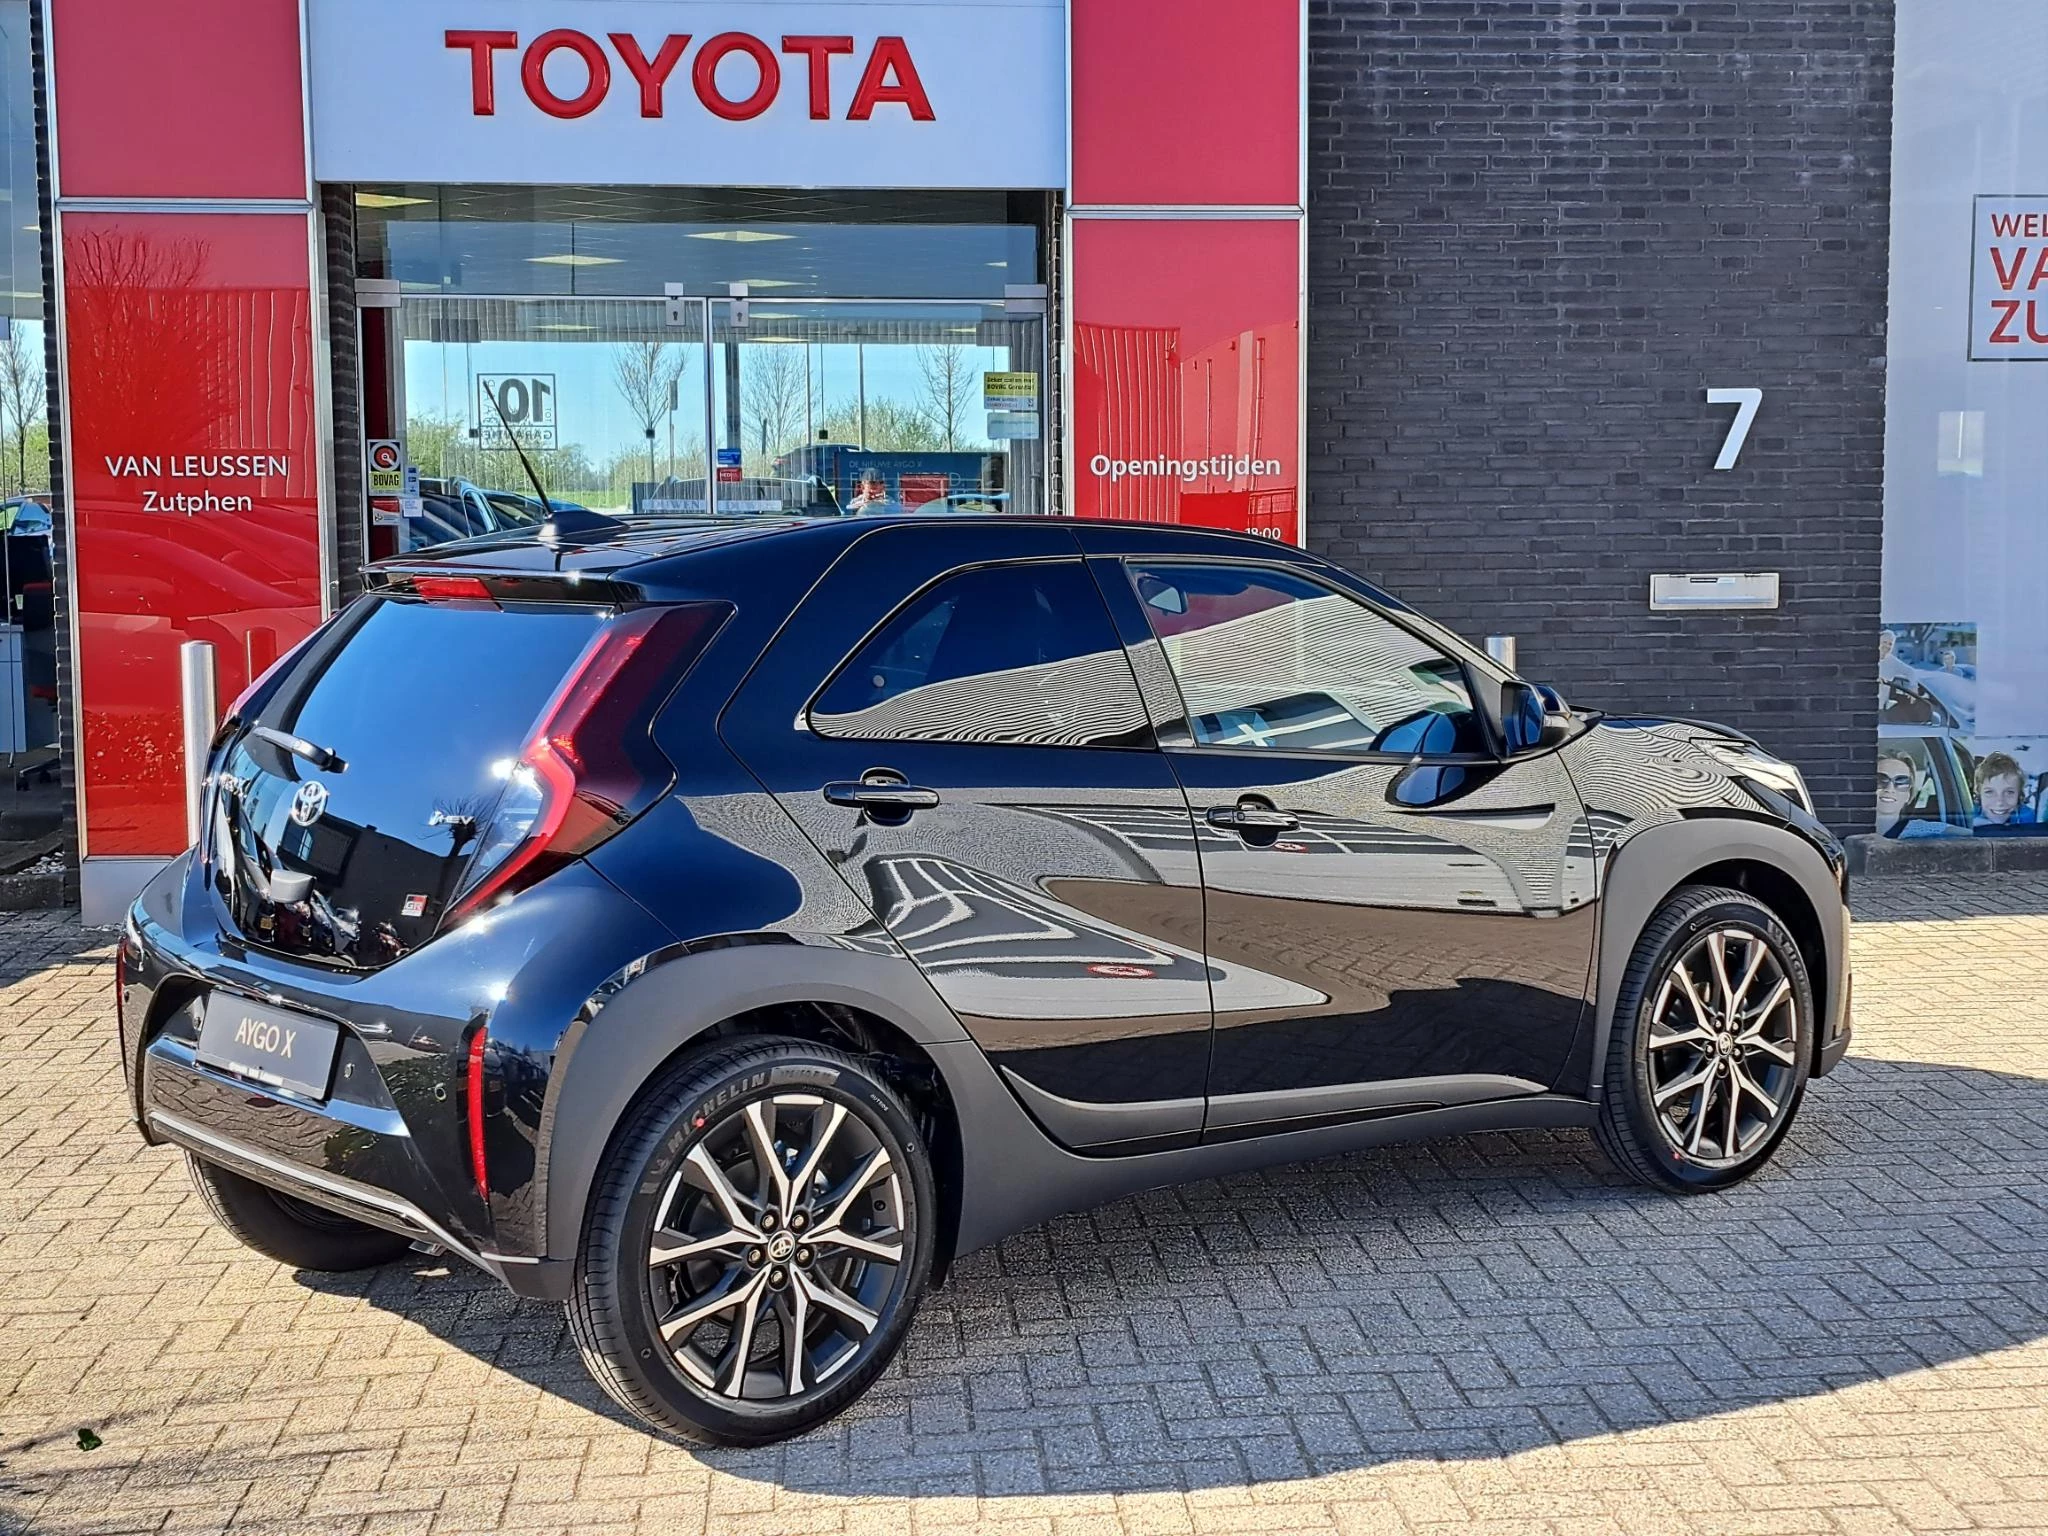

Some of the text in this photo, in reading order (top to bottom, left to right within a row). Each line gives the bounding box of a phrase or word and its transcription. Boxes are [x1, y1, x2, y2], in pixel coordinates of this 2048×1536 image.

[445, 28, 936, 121] TOYOTA
[1707, 388, 1763, 470] 7
[105, 456, 288, 477] VAN LEUSSEN
[373, 474, 400, 487] BOVAG
[1090, 454, 1281, 482] Openingstijden
[143, 490, 252, 517] Zutphen
[234, 1016, 297, 1058] AYGO X
[667, 1071, 765, 1150] MICHELIN
